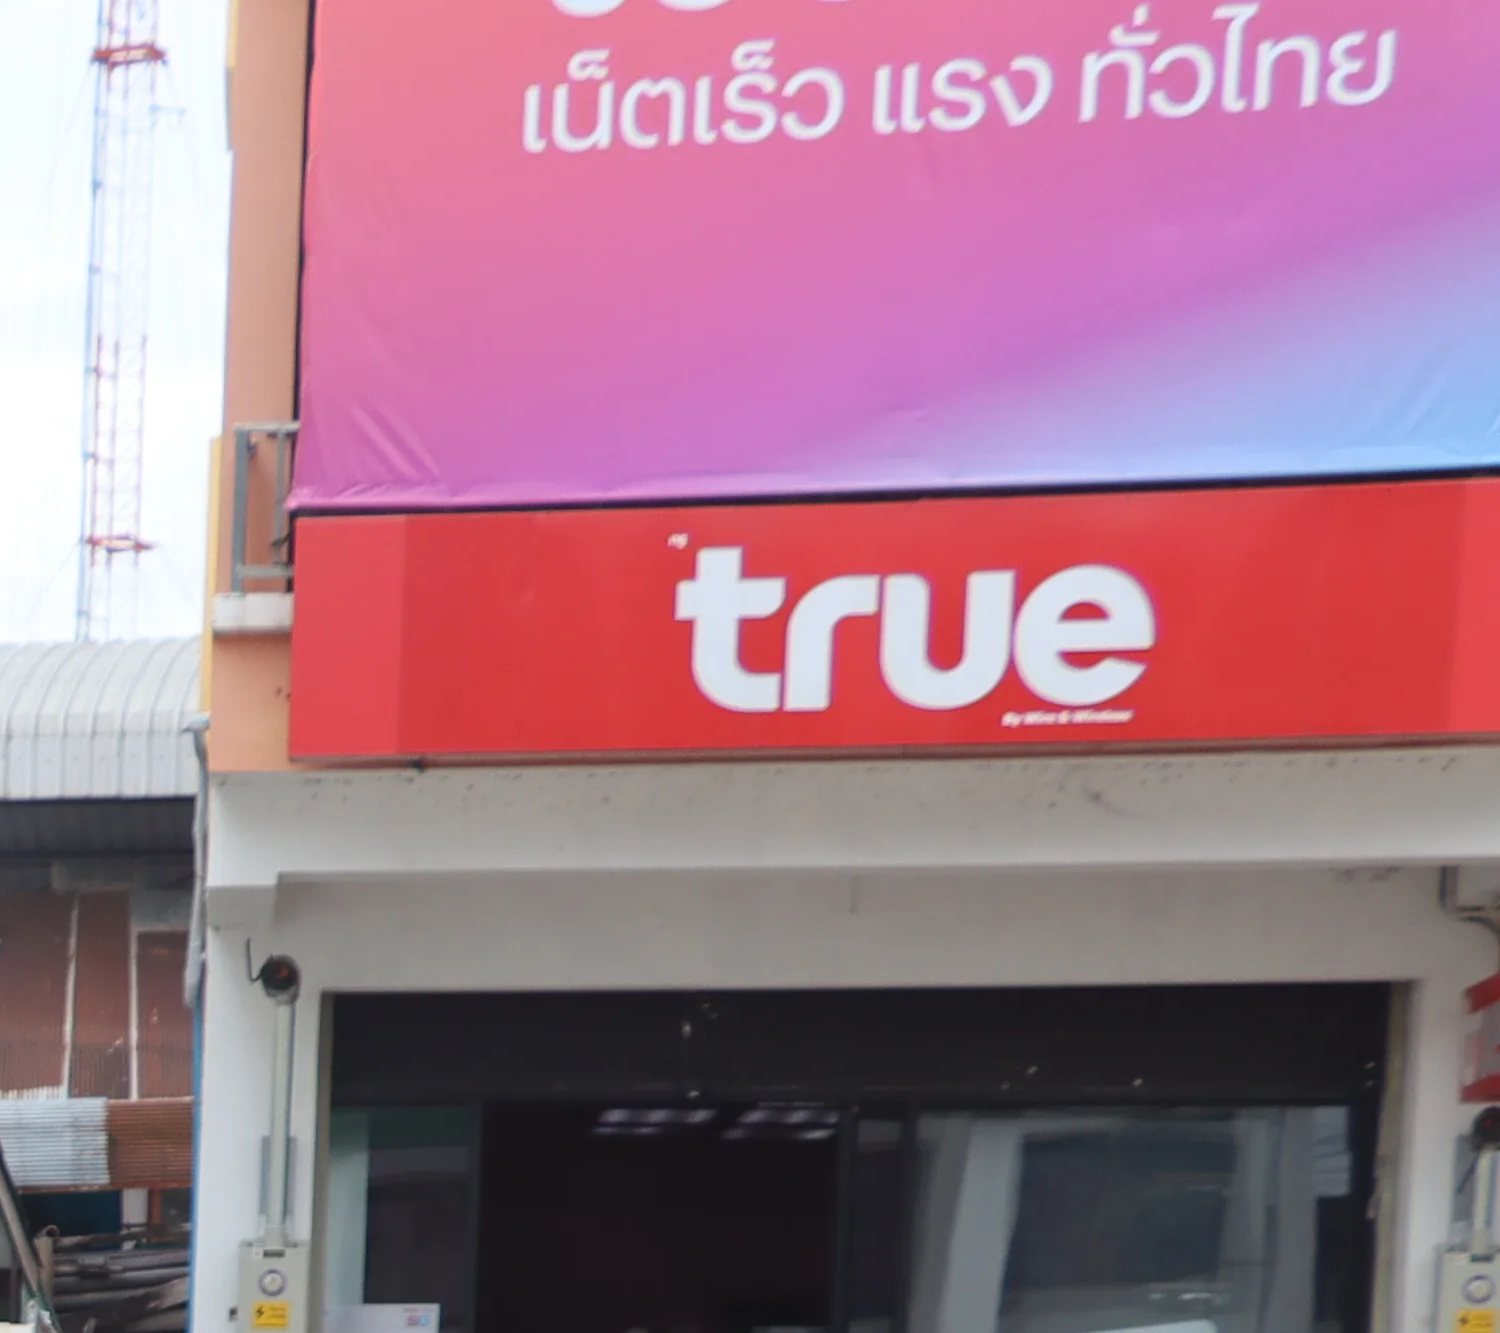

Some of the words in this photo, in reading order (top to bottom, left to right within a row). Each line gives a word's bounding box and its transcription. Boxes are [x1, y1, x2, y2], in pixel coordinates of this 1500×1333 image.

[522, 38, 845, 153] เน็ตเร็ว
[871, 54, 1054, 135] แรง
[1078, 2, 1397, 122] ทั่วไทย
[674, 545, 1156, 712] true
